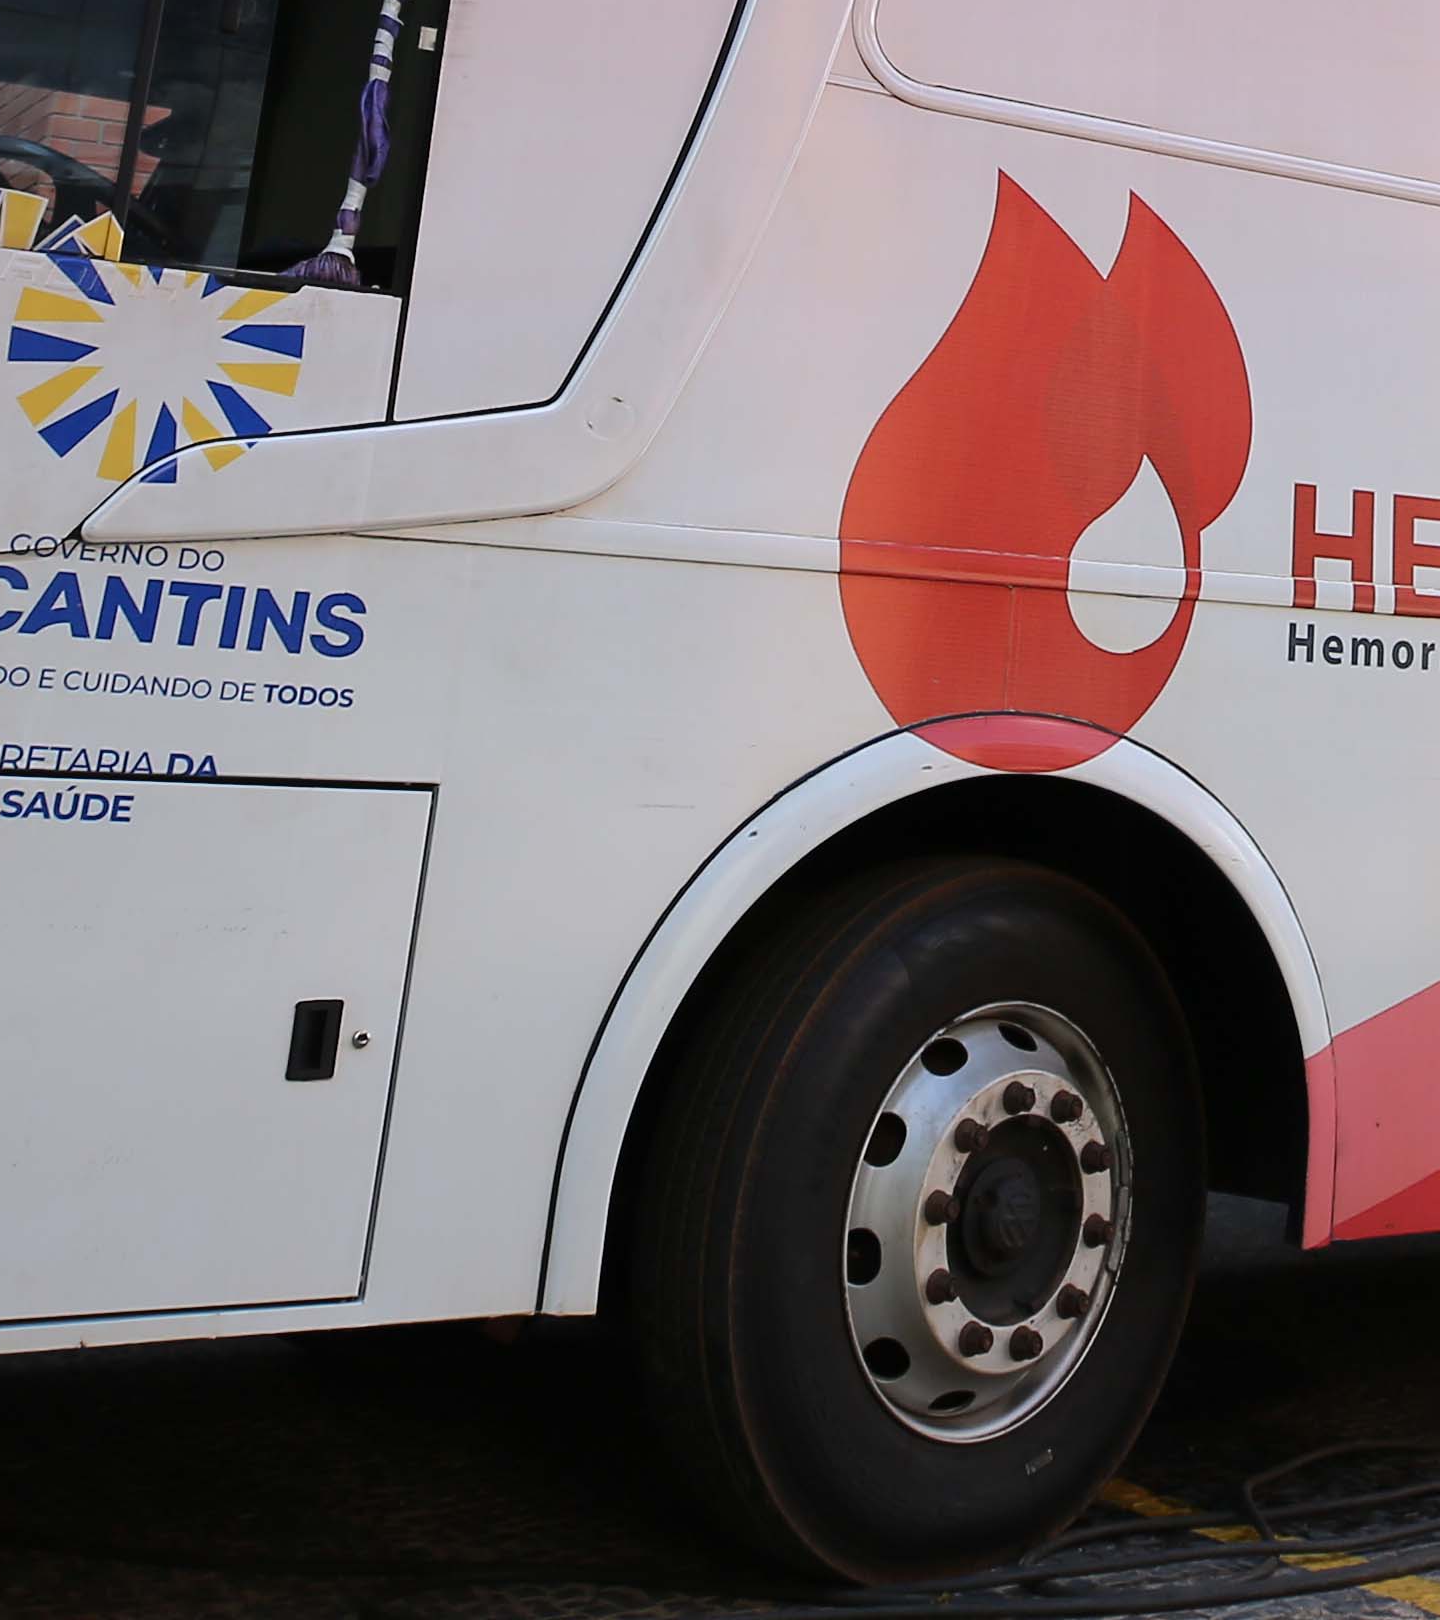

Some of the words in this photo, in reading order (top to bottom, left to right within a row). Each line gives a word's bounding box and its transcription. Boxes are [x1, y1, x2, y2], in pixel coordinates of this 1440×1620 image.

[10, 533, 169, 567] GOVERNO
[178, 547, 225, 572] DO
[37, 668, 57, 689] E
[62, 670, 213, 700] CUIDANDO
[219, 681, 257, 703] DE
[262, 683, 355, 709] TODOS
[165, 752, 218, 777] DA
[0, 785, 135, 823] SAÚDE
